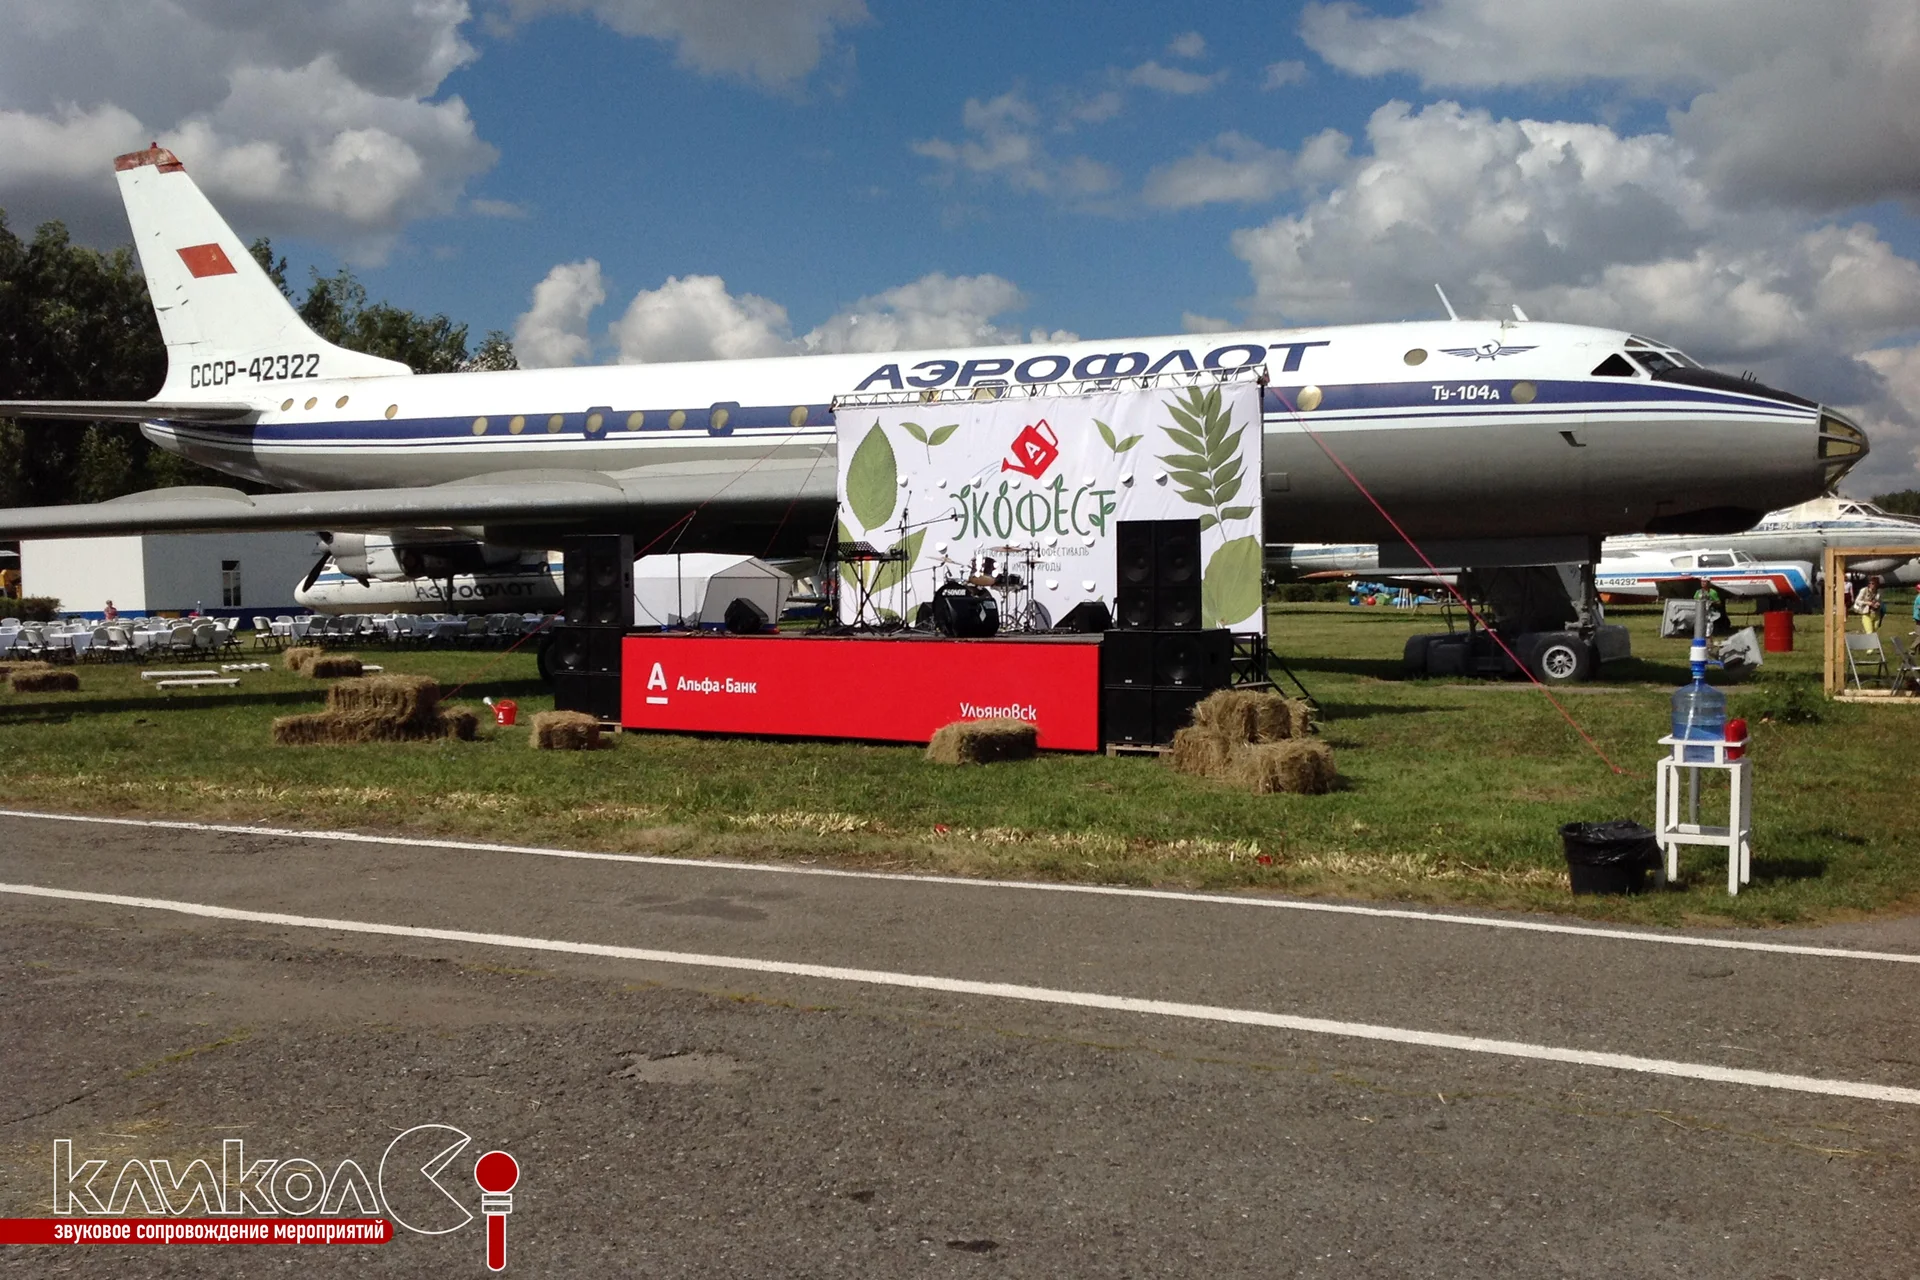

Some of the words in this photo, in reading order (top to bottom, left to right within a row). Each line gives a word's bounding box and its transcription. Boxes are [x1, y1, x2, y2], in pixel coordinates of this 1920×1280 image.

[190, 353, 320, 388] СССР-42322
[853, 340, 1331, 391] АЭРОФЛОТ
[949, 474, 1117, 541] ЭКОФЕСТ
